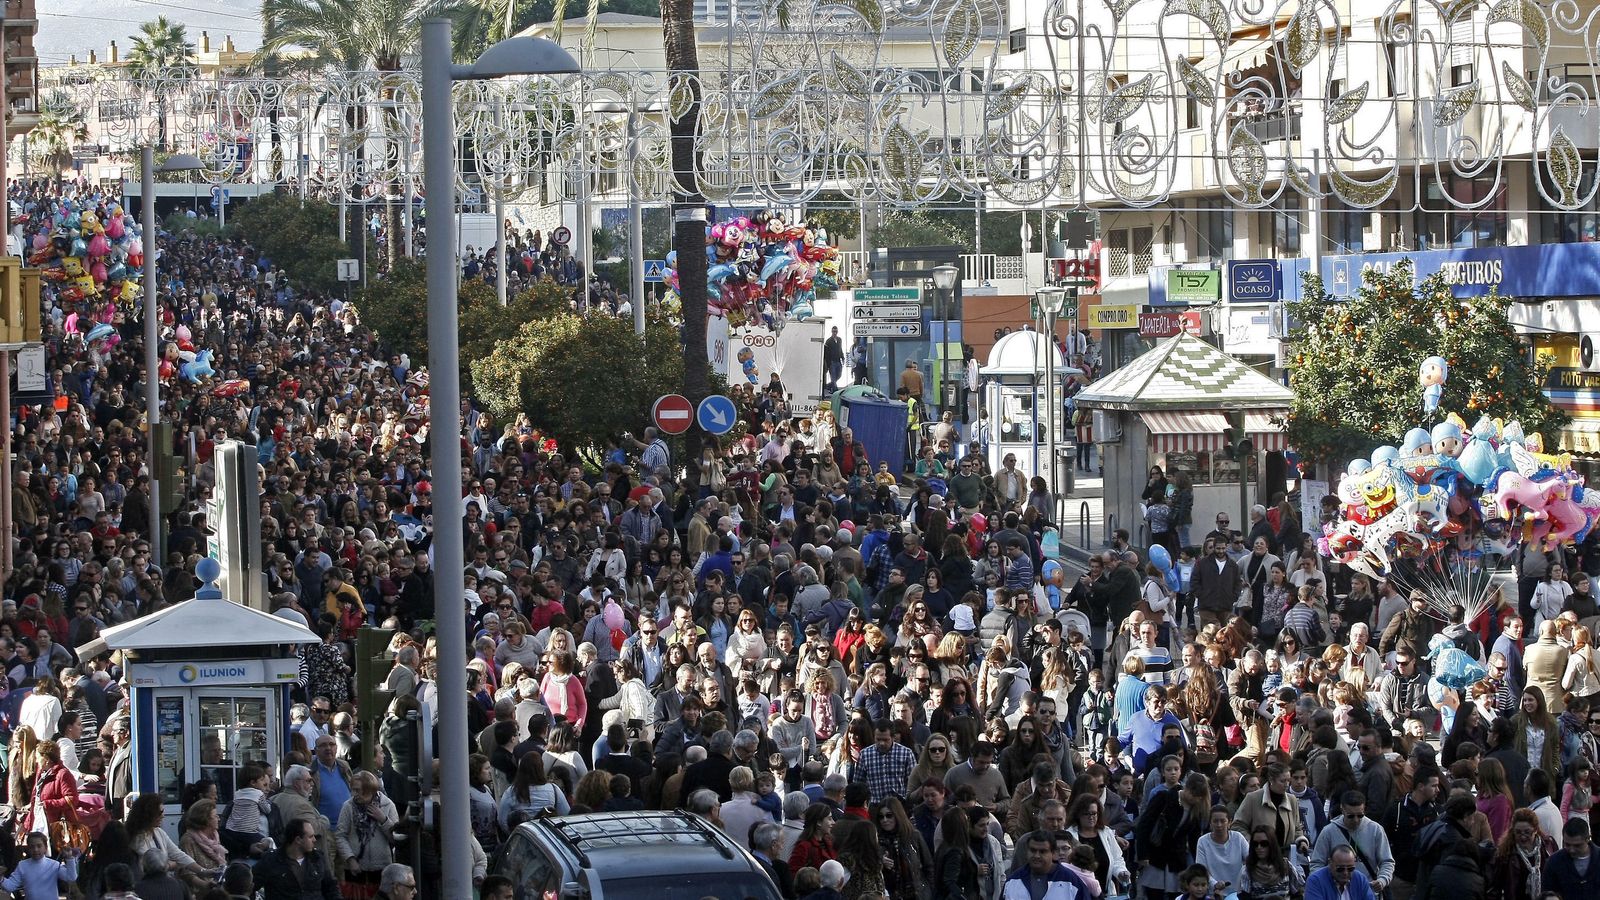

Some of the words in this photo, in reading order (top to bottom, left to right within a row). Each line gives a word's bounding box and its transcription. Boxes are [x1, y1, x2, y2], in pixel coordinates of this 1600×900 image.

[1236, 284, 1271, 294] OCASO
[1097, 310, 1117, 322] COMPRO
[1117, 310, 1128, 322] ORO
[1140, 315, 1170, 334] ZAPATERIA
[744, 336, 774, 346] TNT
[1560, 371, 1581, 387] FOTO
[199, 667, 246, 678] ILUNION
